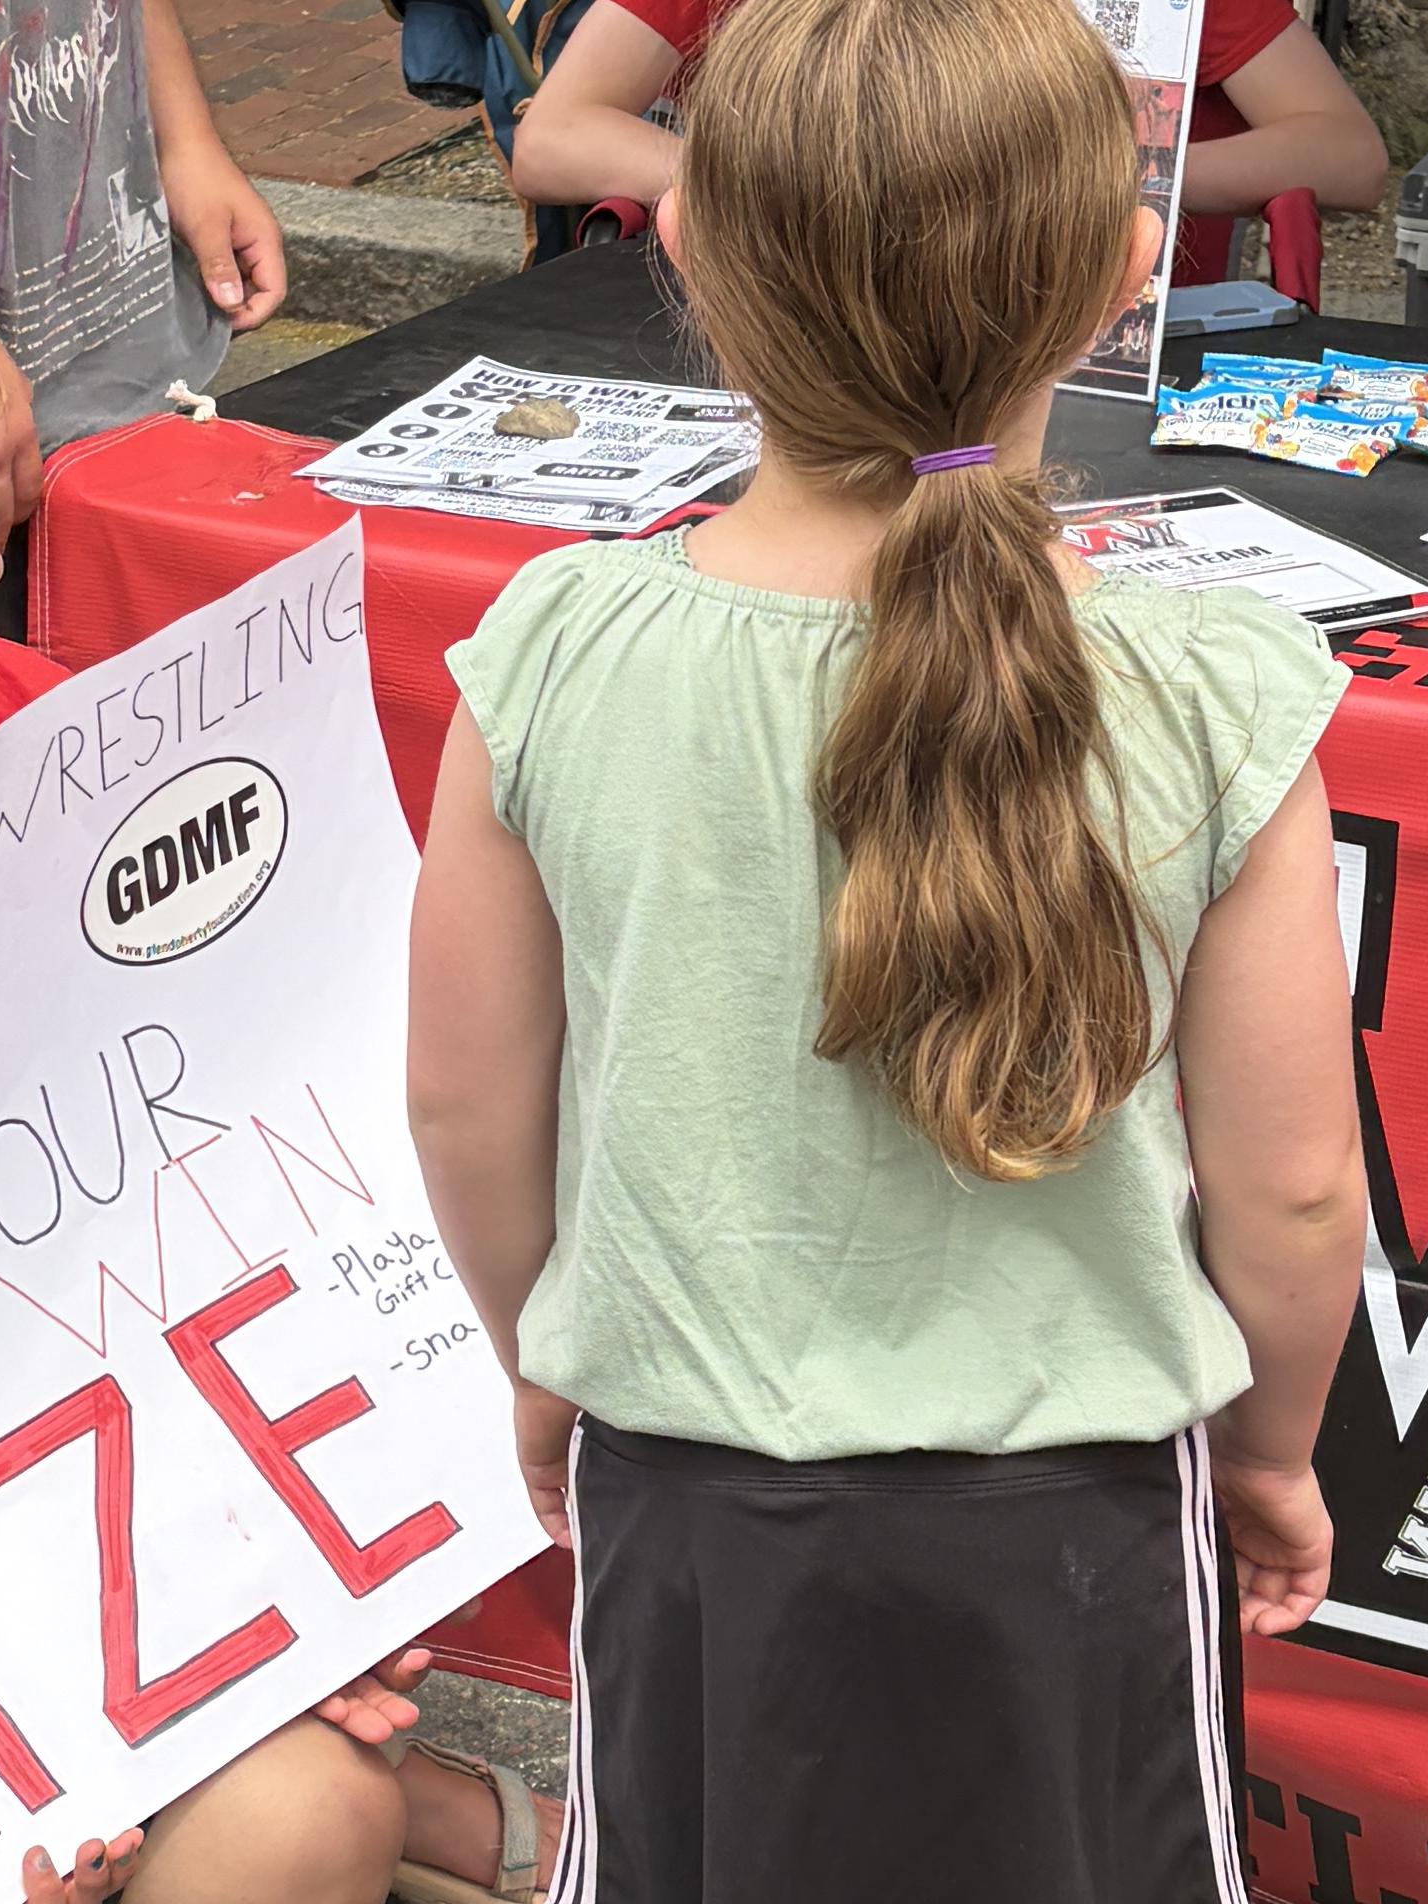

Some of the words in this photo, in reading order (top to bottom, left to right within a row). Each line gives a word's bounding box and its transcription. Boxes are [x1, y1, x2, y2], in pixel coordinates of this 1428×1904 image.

[472, 369, 538, 390] HOW
[546, 382, 582, 394] TO
[588, 386, 649, 404] WIN
[656, 394, 673, 403] A
[551, 465, 623, 478] RAFFLE
[1125, 558, 1175, 577] THE
[1184, 545, 1272, 567] TEAM
[105, 782, 261, 926] GDMF
[375, 1269, 429, 1315] Gift
[389, 1322, 479, 1371] -Sna
